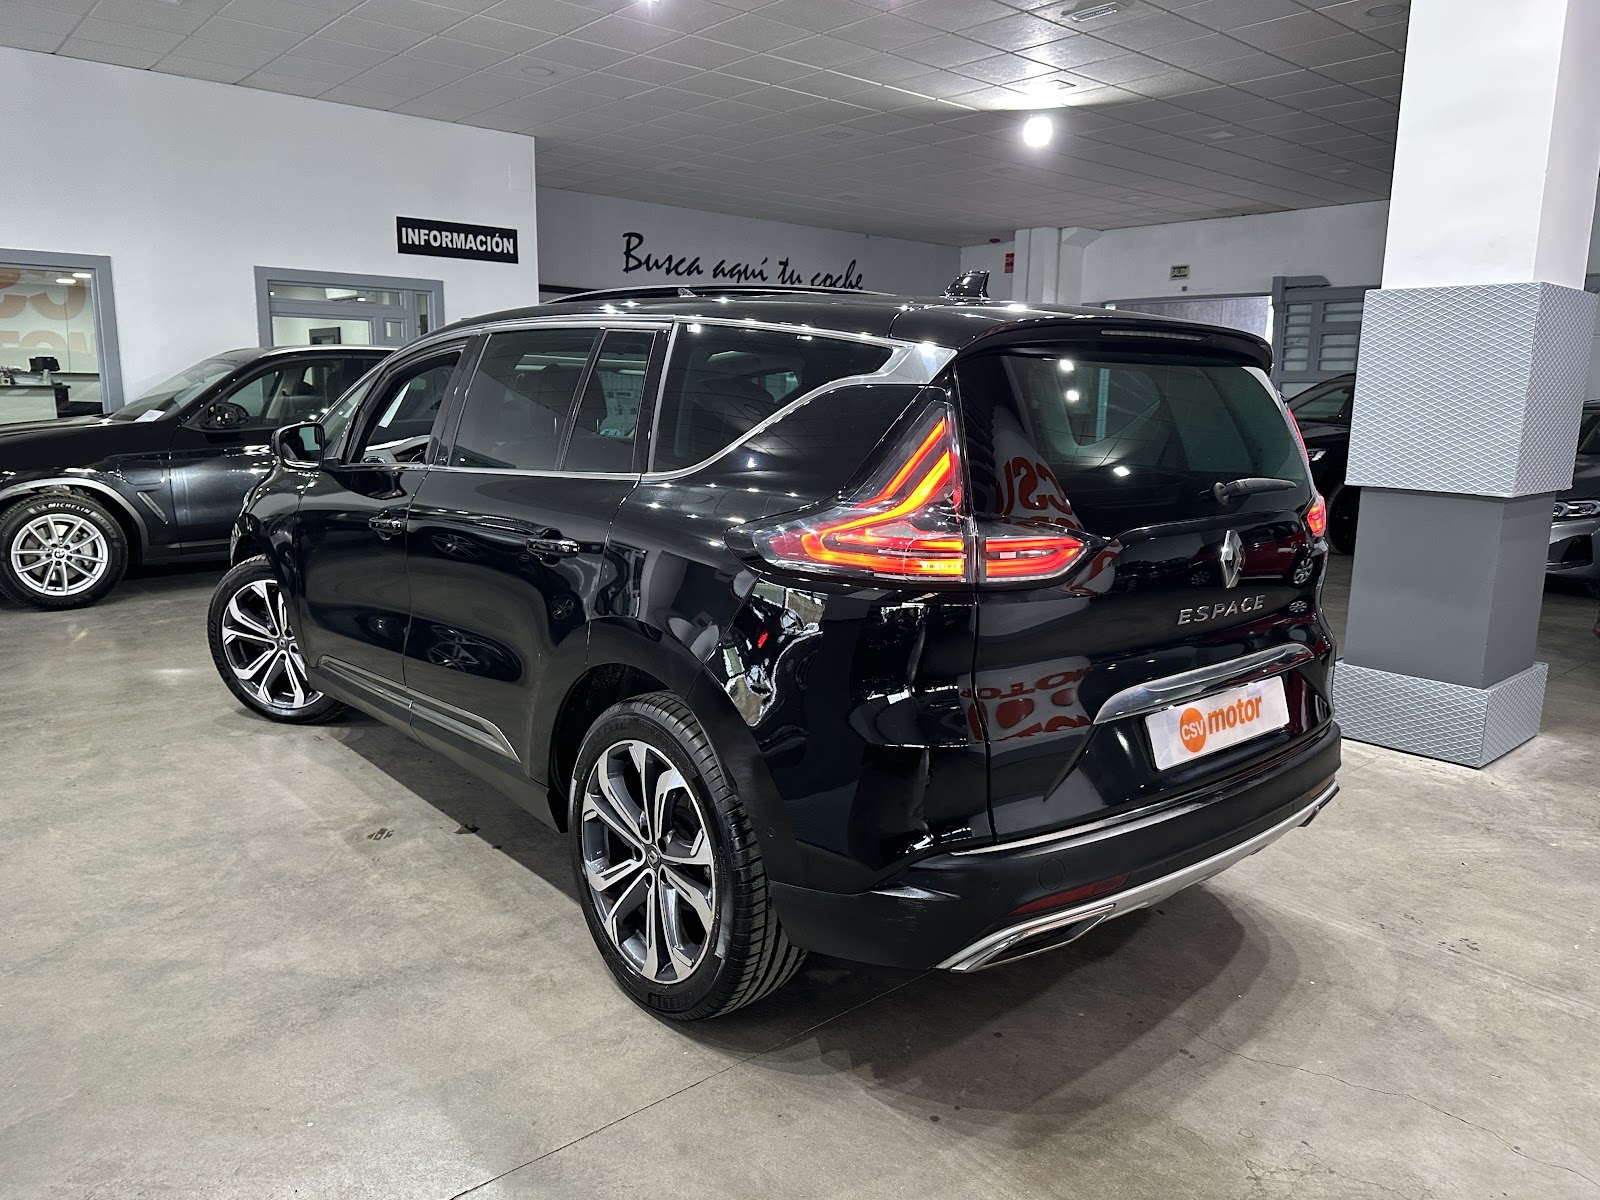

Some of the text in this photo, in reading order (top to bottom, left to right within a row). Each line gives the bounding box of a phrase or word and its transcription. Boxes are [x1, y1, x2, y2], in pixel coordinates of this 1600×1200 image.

[401, 227, 514, 254] INFORMACIÓN
[622, 232, 864, 290] Busca aquí tu coche
[1171, 267, 1189, 277] SALIDA
[48, 502, 91, 514] MICHELIN
[1177, 594, 1266, 625] ESPACE
[1207, 695, 1262, 735] motor
